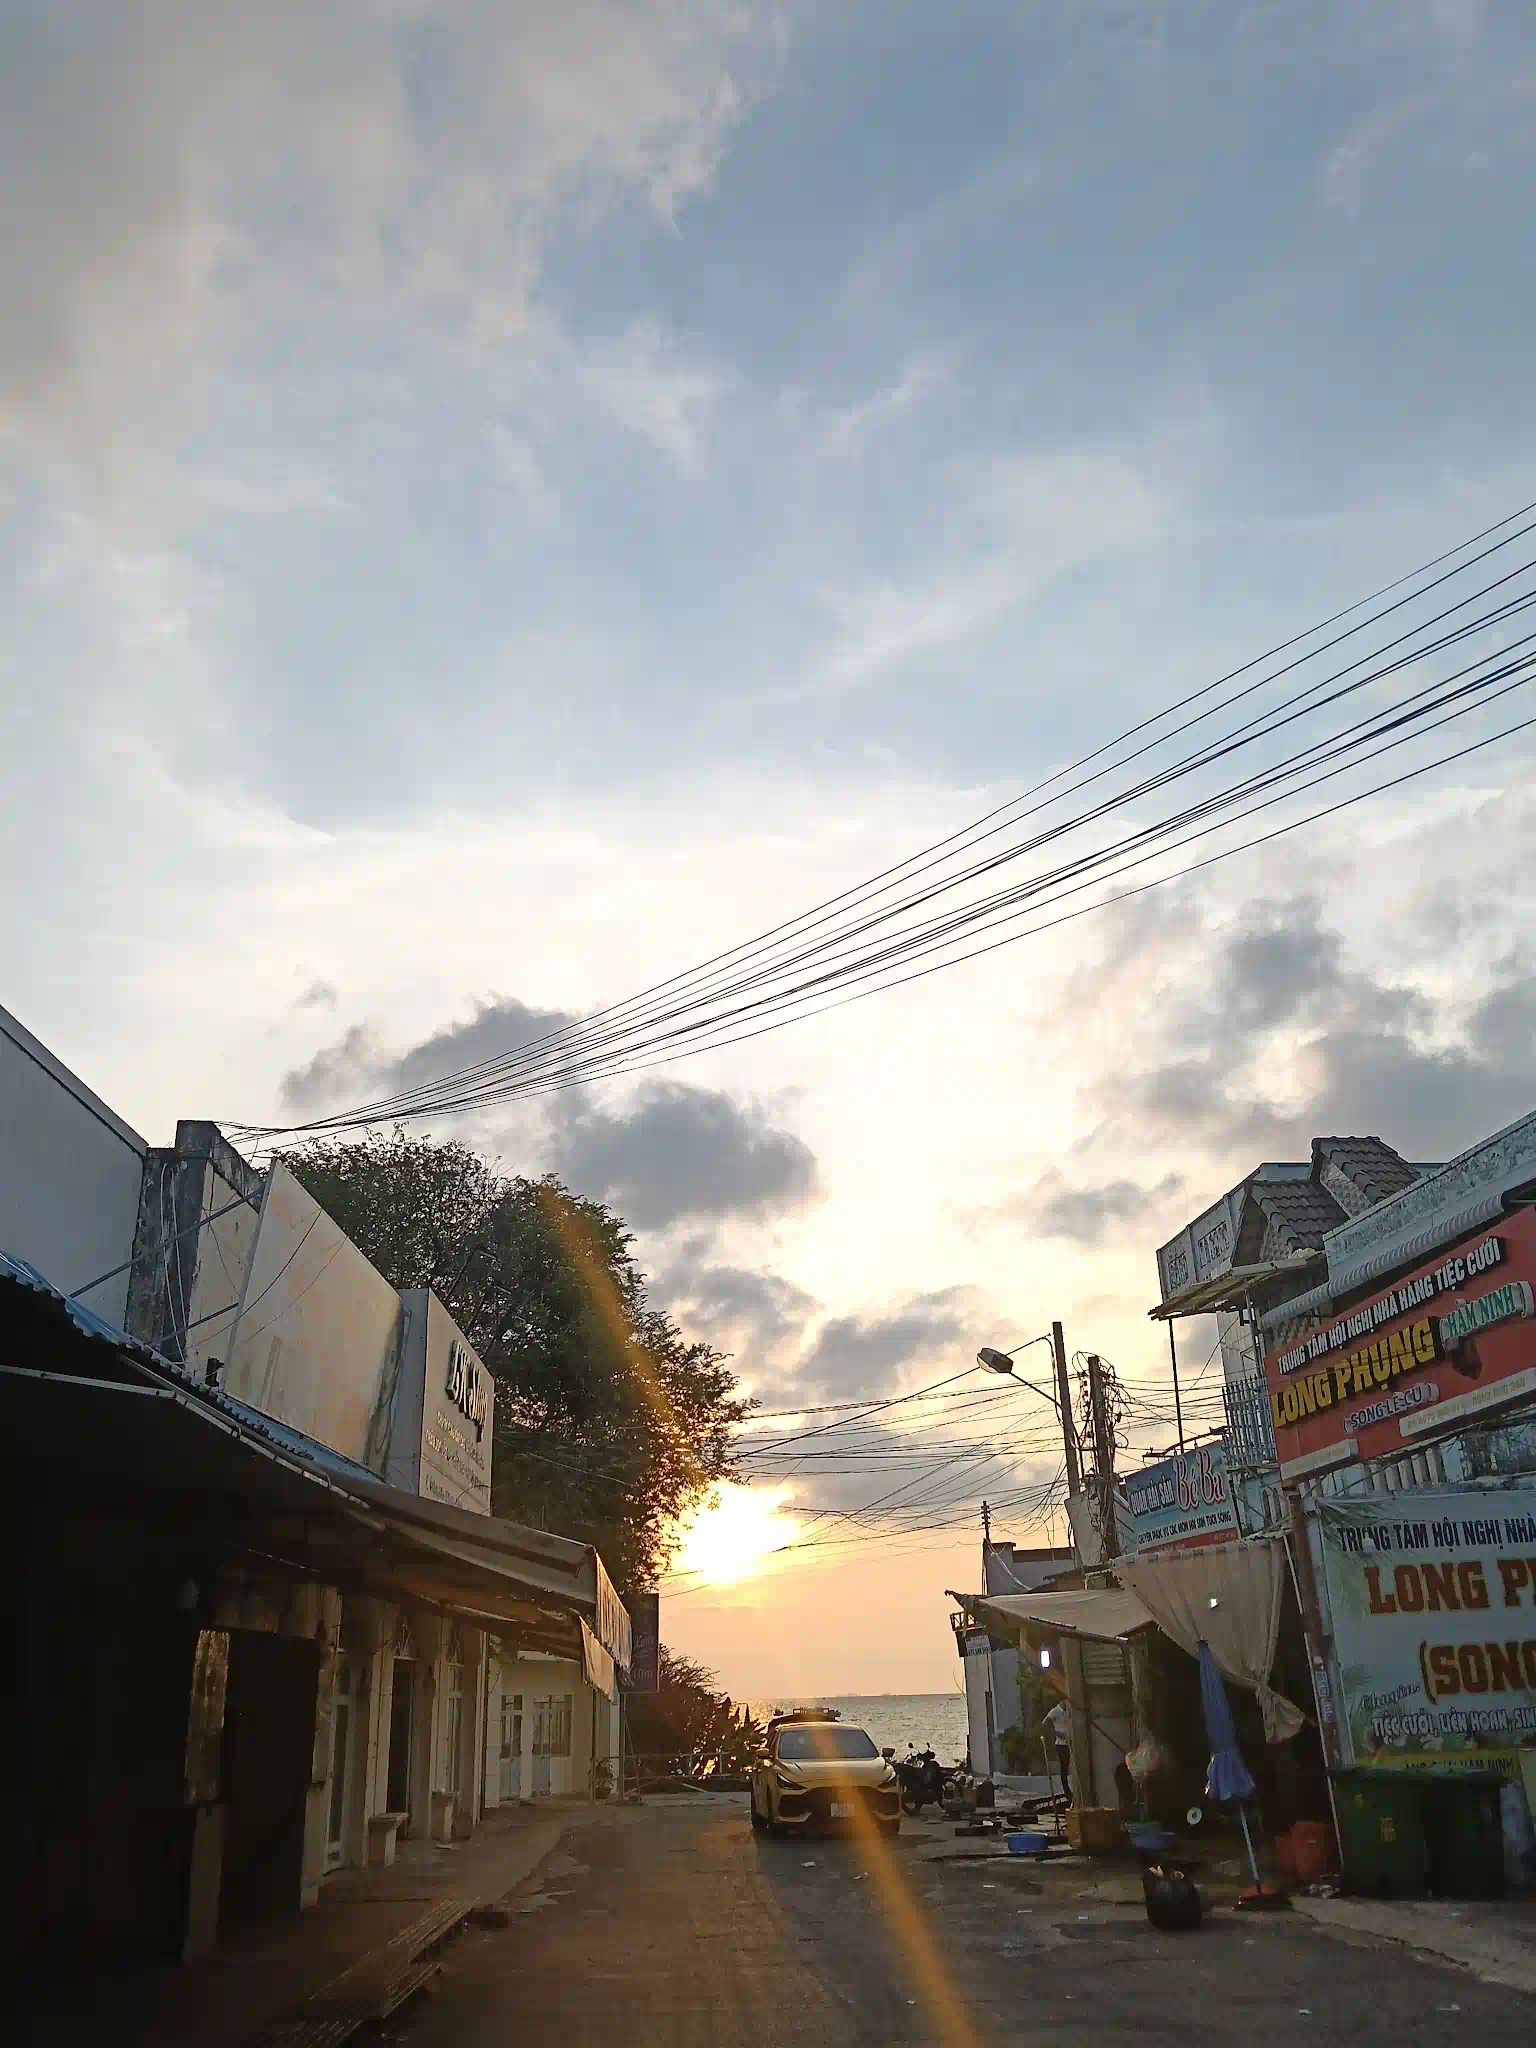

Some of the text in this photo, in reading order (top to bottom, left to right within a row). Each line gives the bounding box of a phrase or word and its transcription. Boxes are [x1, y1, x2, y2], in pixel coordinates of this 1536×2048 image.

[1277, 1237, 1501, 1375] TRUNG TÂM HỘI NGHỊ NHÀ HÀNG TIỆC CƯỚI
[1270, 1370, 1332, 1428] LONG
[1333, 1316, 1435, 1400] PHỤNG
[1173, 1456, 1199, 1512] Bé
[1195, 1447, 1226, 1504] Ba
[1393, 1520, 1429, 1549] TÂM
[1432, 1517, 1460, 1552] HỘI
[1463, 1519, 1504, 1551] NGHỊ
[1364, 1561, 1490, 1614] LONG
[1372, 1710, 1401, 1745] TIỆC
[1439, 1707, 1467, 1733] LIÊN
